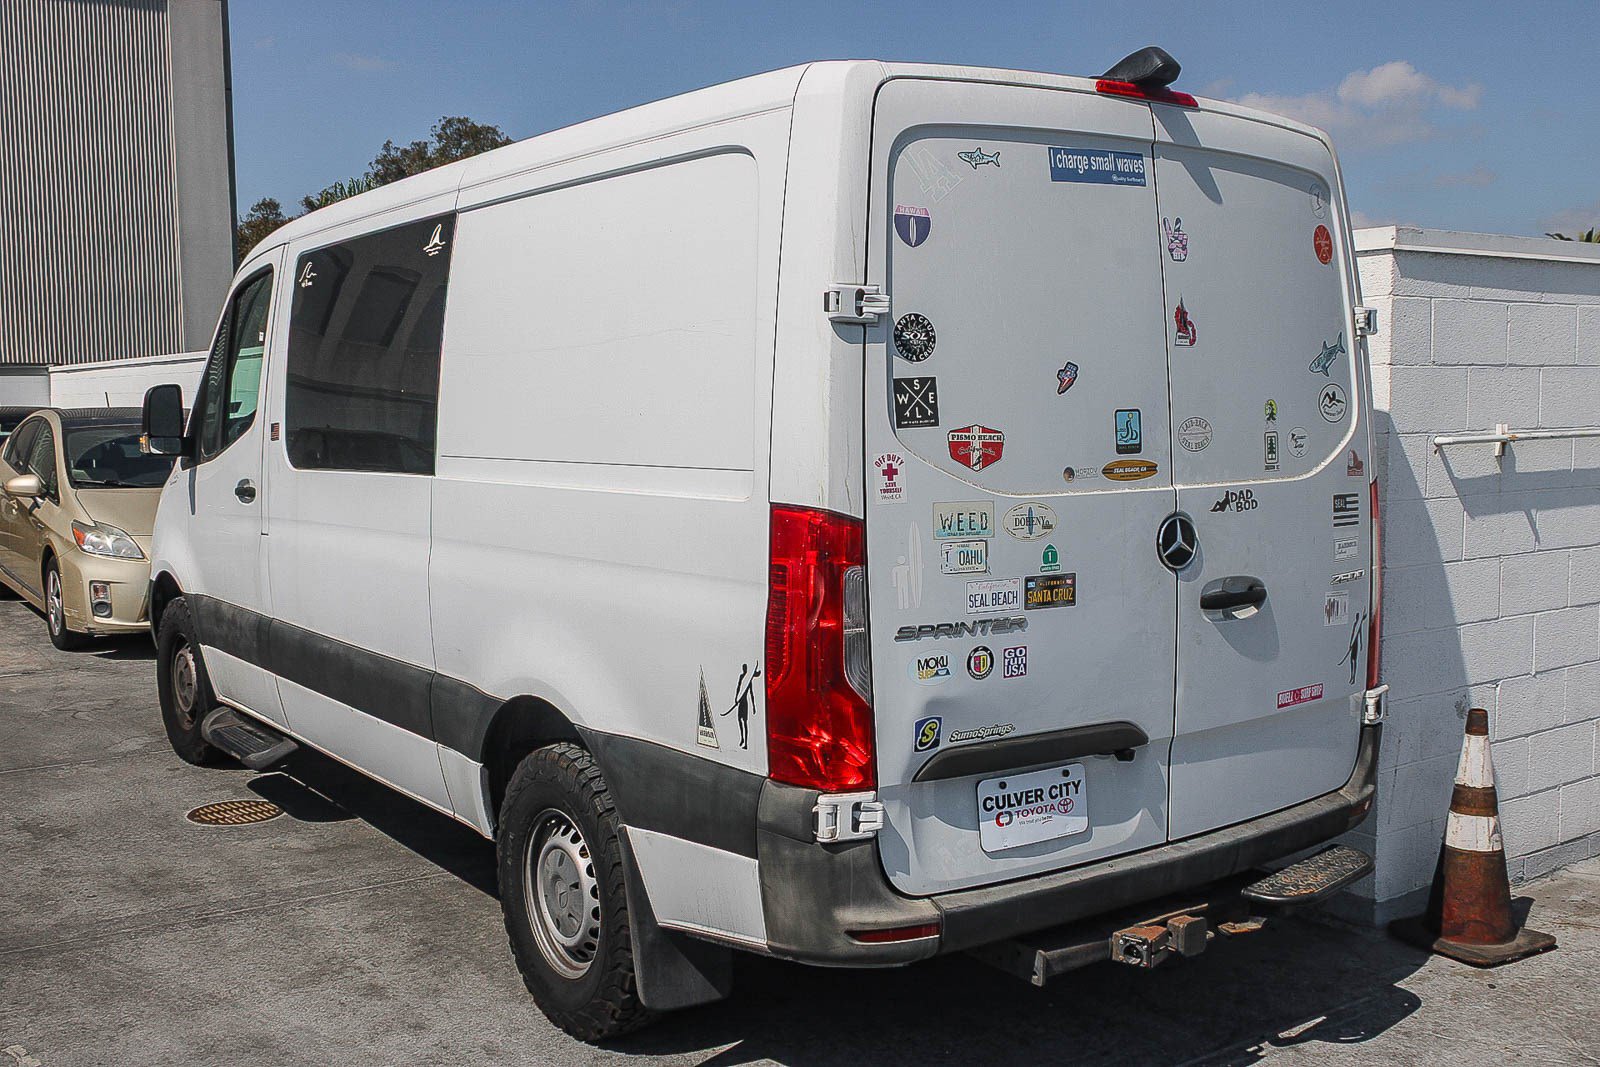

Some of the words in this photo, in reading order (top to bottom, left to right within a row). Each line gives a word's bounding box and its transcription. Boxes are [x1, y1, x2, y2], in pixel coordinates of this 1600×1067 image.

[1050, 149, 1054, 168] I
[1056, 149, 1089, 174] charge
[1090, 152, 1115, 171] small
[1116, 159, 1144, 173] waves
[895, 315, 915, 335] SANTA
[918, 315, 935, 337] CRUZ
[901, 331, 928, 341] SOL
[895, 341, 917, 361] SANTA
[918, 342, 935, 361] CRUZ
[914, 379, 920, 390] S
[896, 393, 910, 405] W
[929, 392, 935, 403] E
[916, 407, 922, 418] L
[951, 433, 976, 441] PISMO
[977, 433, 1002, 441] BEACH
[874, 455, 887, 468] OFF
[887, 453, 904, 465] DUTY
[1230, 489, 1253, 503] DAD
[1236, 499, 1258, 512] BOD
[939, 512, 988, 532] WEED
[959, 550, 983, 566] OAHU
[1048, 551, 1052, 561] 1
[969, 593, 989, 608] SEAL
[991, 590, 1018, 606] BEACH
[1027, 592, 1051, 605] SANTA
[1053, 588, 1073, 602] CRUZ
[894, 615, 1027, 642] SPRINTER
[1004, 647, 1025, 658] GO
[917, 655, 948, 671] MOKU
[1004, 656, 1026, 667] run
[1004, 665, 1025, 677] USA
[950, 723, 1014, 742] SumoSprings
[982, 787, 1045, 812] CULVER
[1048, 779, 1082, 799] CITY
[1015, 803, 1056, 820] TOYOTA
